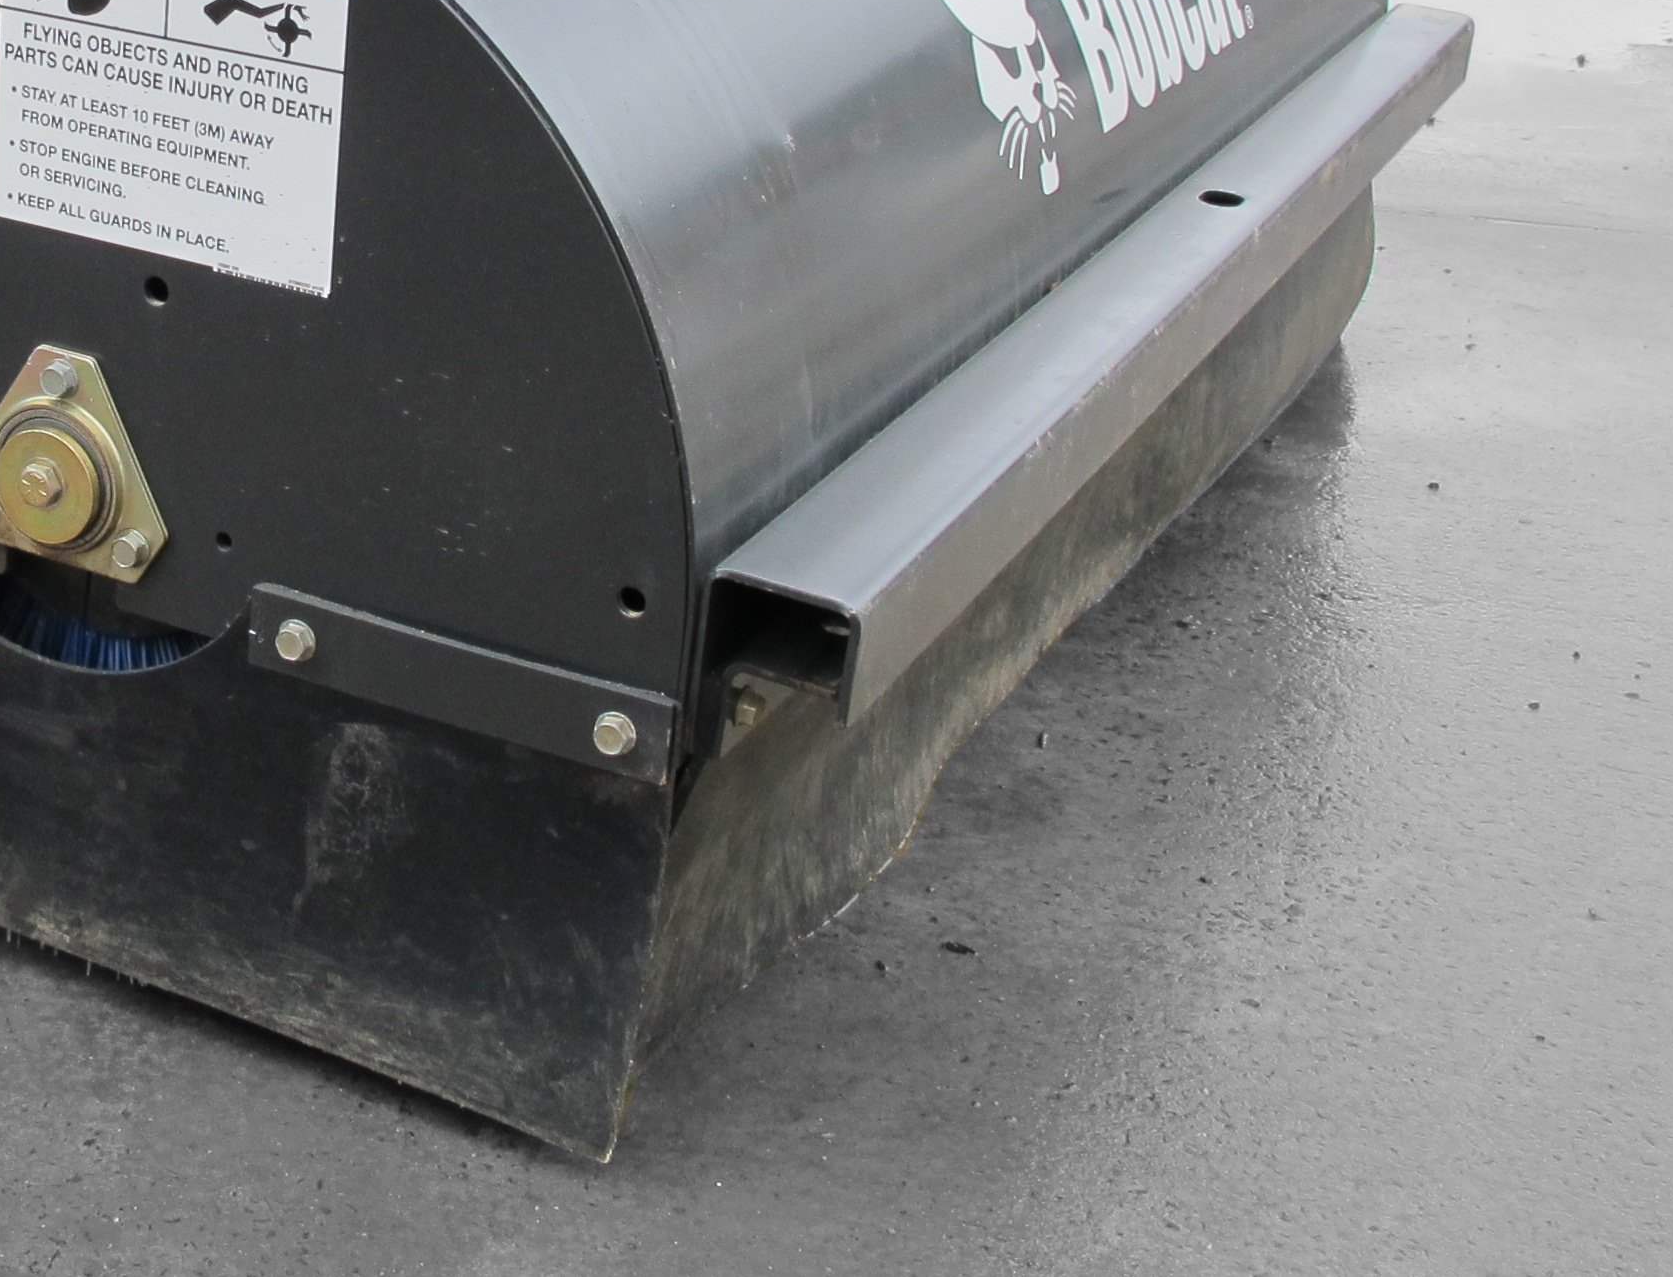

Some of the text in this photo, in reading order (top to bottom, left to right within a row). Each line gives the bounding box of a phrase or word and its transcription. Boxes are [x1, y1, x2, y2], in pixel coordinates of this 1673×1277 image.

[5, 44, 333, 125] PARTS CAN CAUSE INJURY OR DEATH
[23, 22, 308, 95] FLYING OBJECTS AND ROTATING
[22, 85, 274, 150] STAY AT LEAST 10 FEET (3M) AWAY
[22, 110, 250, 171] FROM OPERATING EQUIPMENT.
[19, 140, 265, 206] STOP ENGINE BEFORE CLEANING
[19, 163, 126, 199] OR SERVICING.
[17, 192, 230, 253] KEEP ALL GUARDS IN PLACE.
